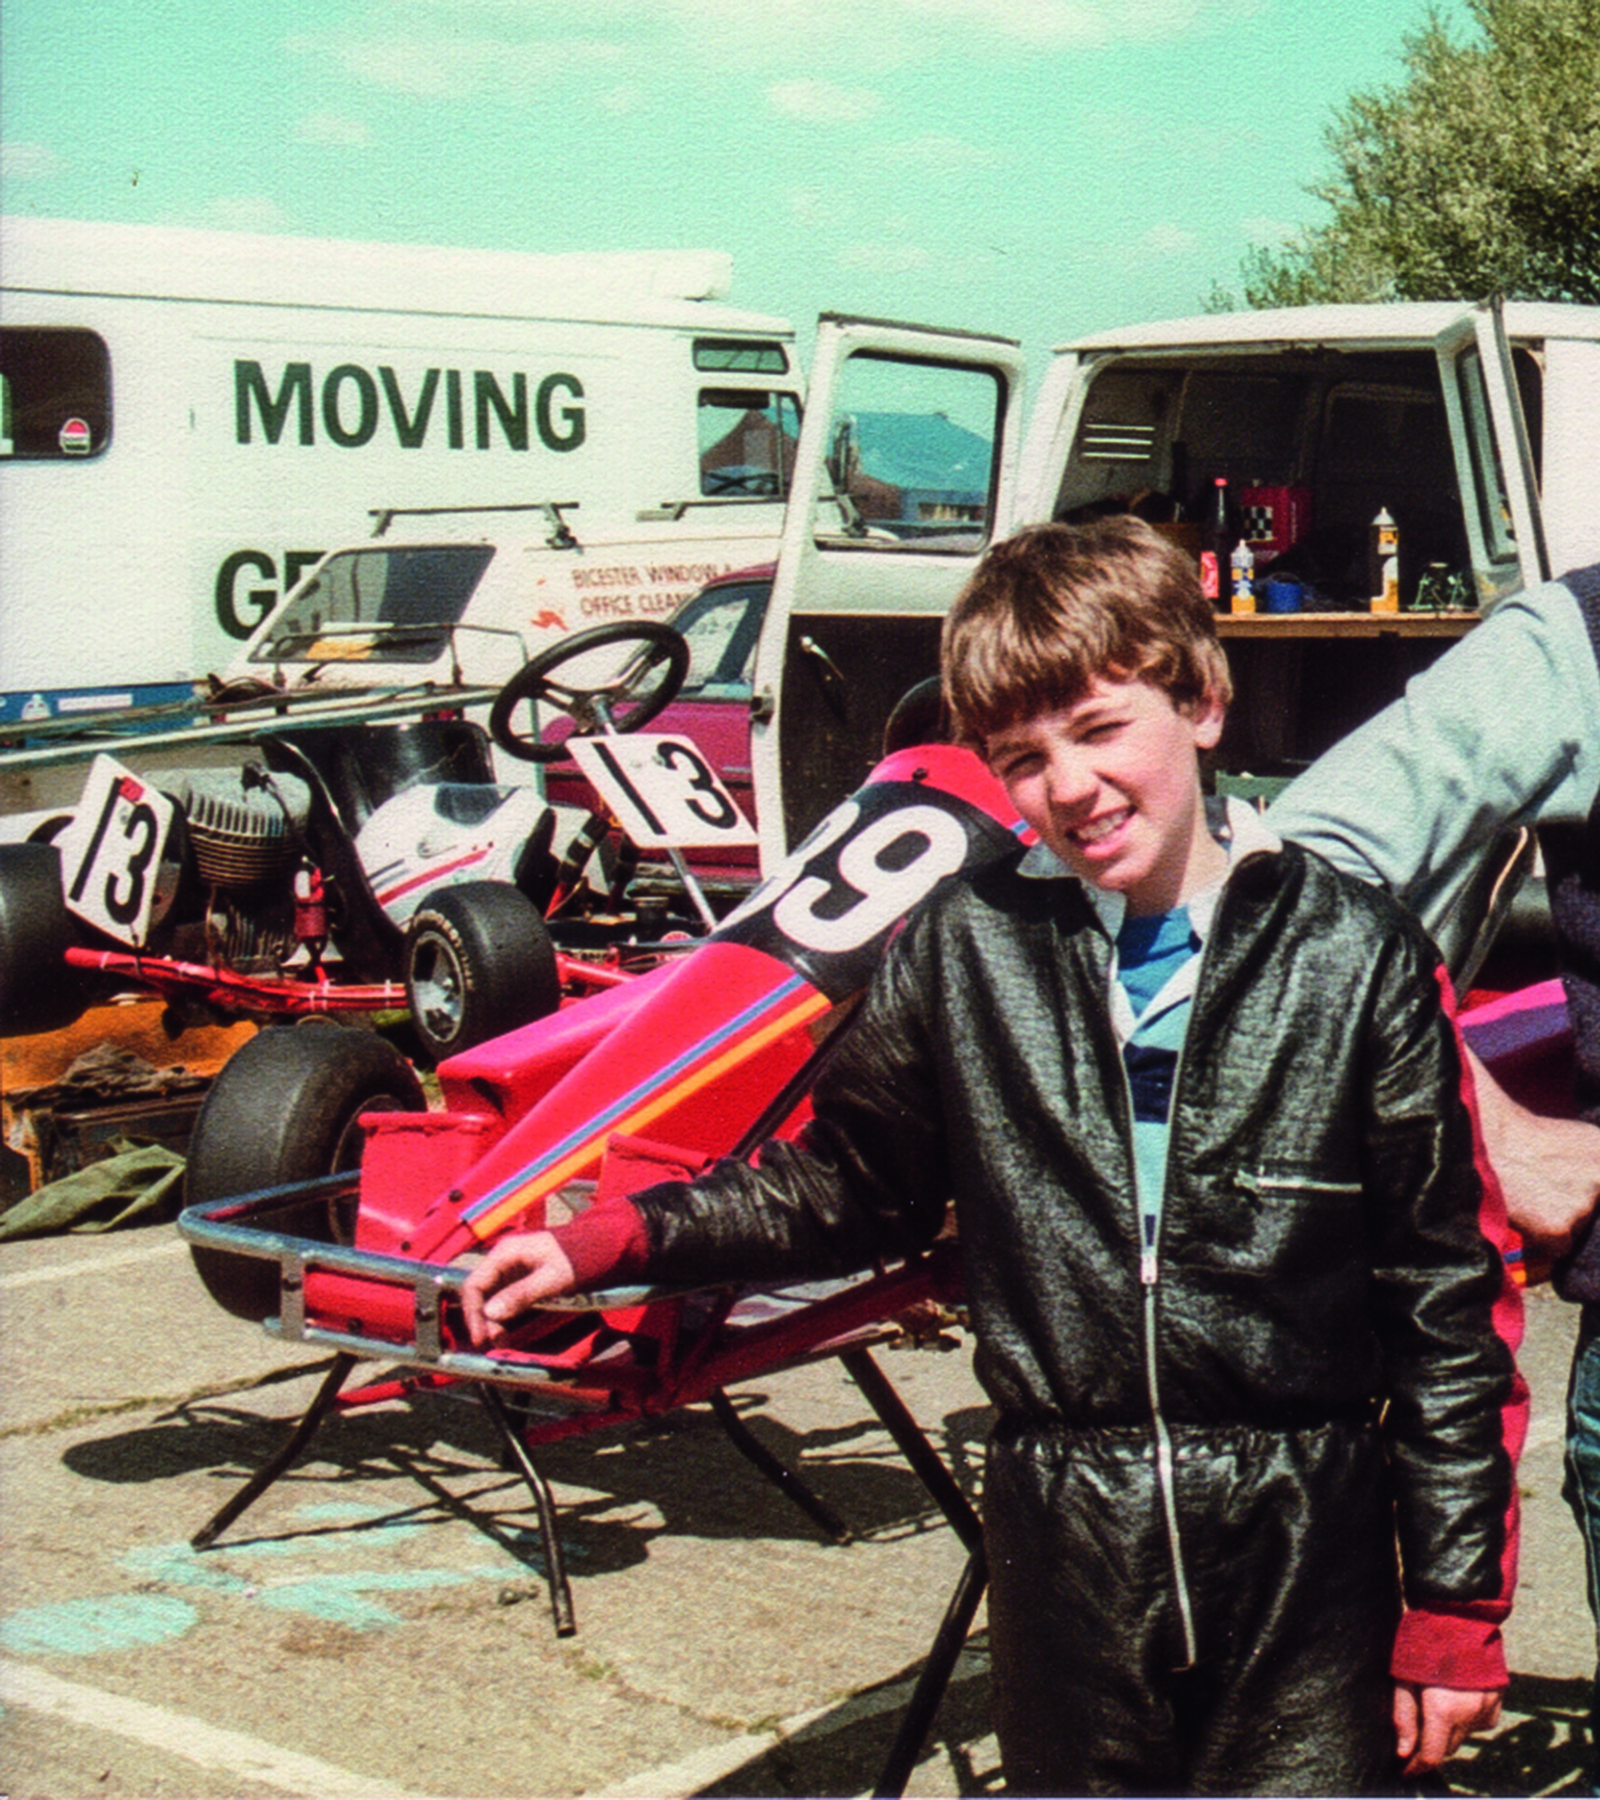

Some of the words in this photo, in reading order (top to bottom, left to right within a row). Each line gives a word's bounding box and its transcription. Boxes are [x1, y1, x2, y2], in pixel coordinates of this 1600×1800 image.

[235, 360, 586, 452] MOVING
[572, 567, 642, 589] BICESTER
[645, 563, 718, 584] WINDOW
[580, 594, 635, 616] OFFICE
[591, 741, 738, 835] 13
[69, 776, 158, 925] 13
